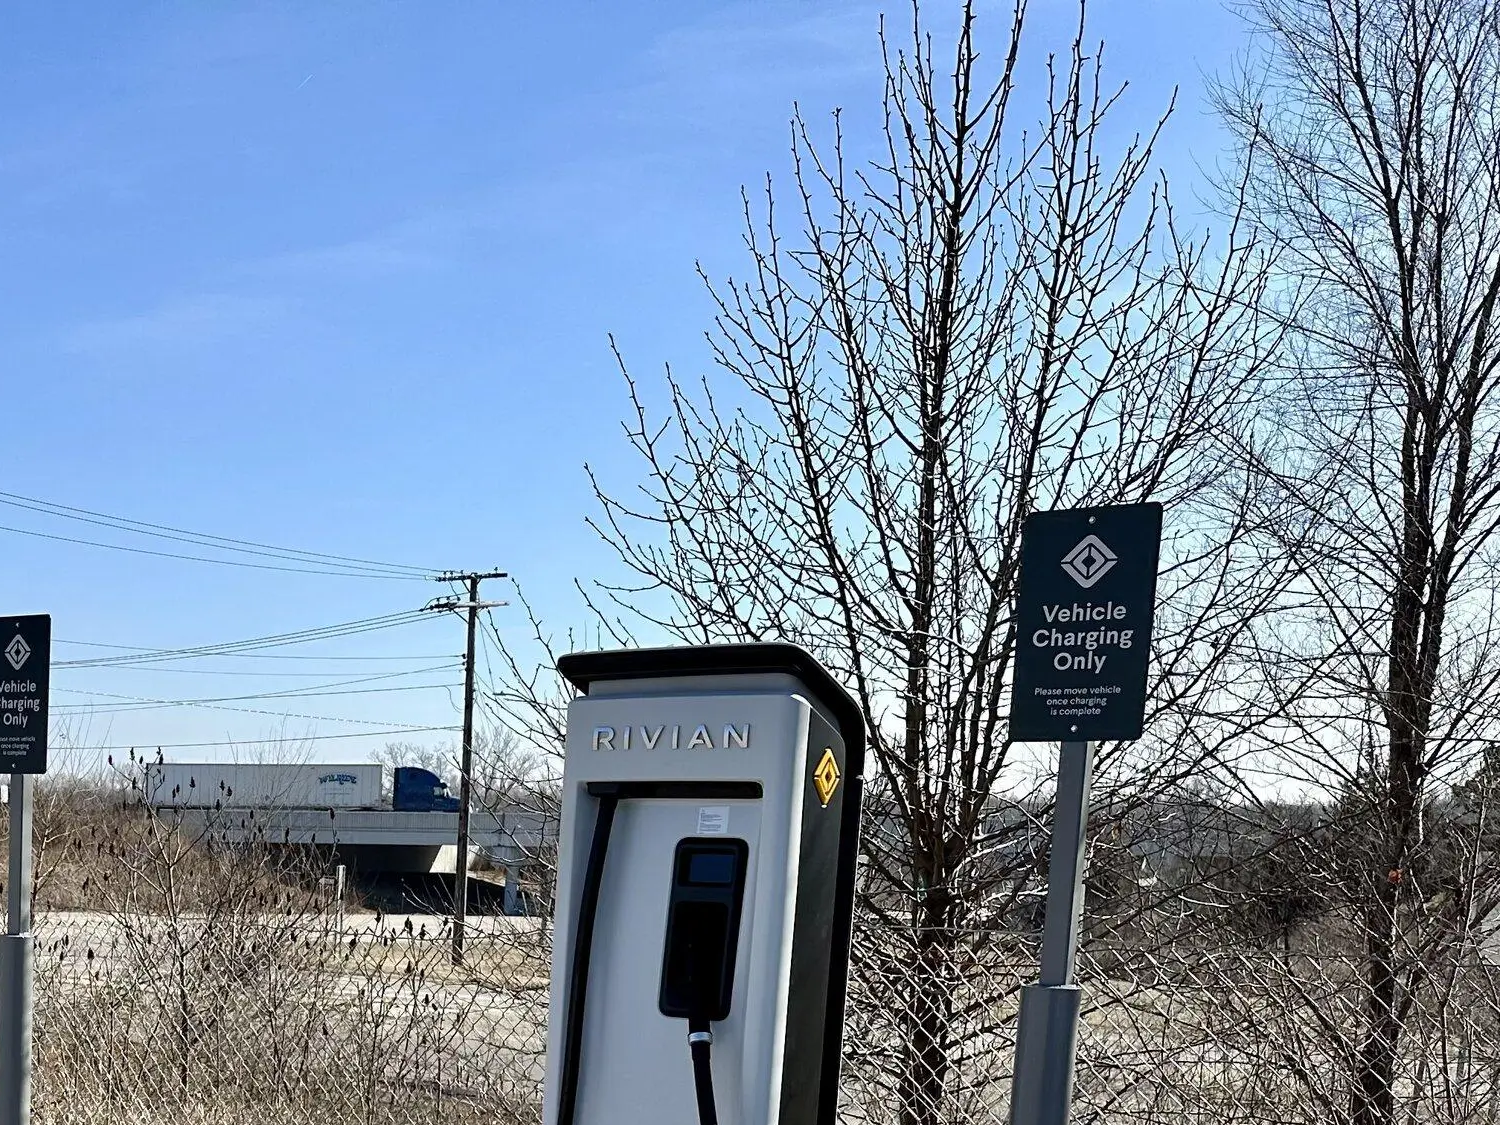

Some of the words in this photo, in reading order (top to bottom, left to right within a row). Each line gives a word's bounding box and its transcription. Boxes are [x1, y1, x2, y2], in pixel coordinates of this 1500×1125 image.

[1042, 601, 1127, 623] Vehicle
[1032, 626, 1134, 649] Charging
[1053, 651, 1107, 674] Only
[1034, 687, 1062, 696] Please
[1063, 687, 1088, 695] move
[1089, 685, 1122, 694] vehicle
[1046, 698, 1069, 706] once
[1069, 696, 1108, 707] charging
[3, 712, 29, 728] Only
[1050, 707, 1058, 716] is
[1059, 706, 1102, 717] complete
[591, 722, 751, 751] RIVIAN
